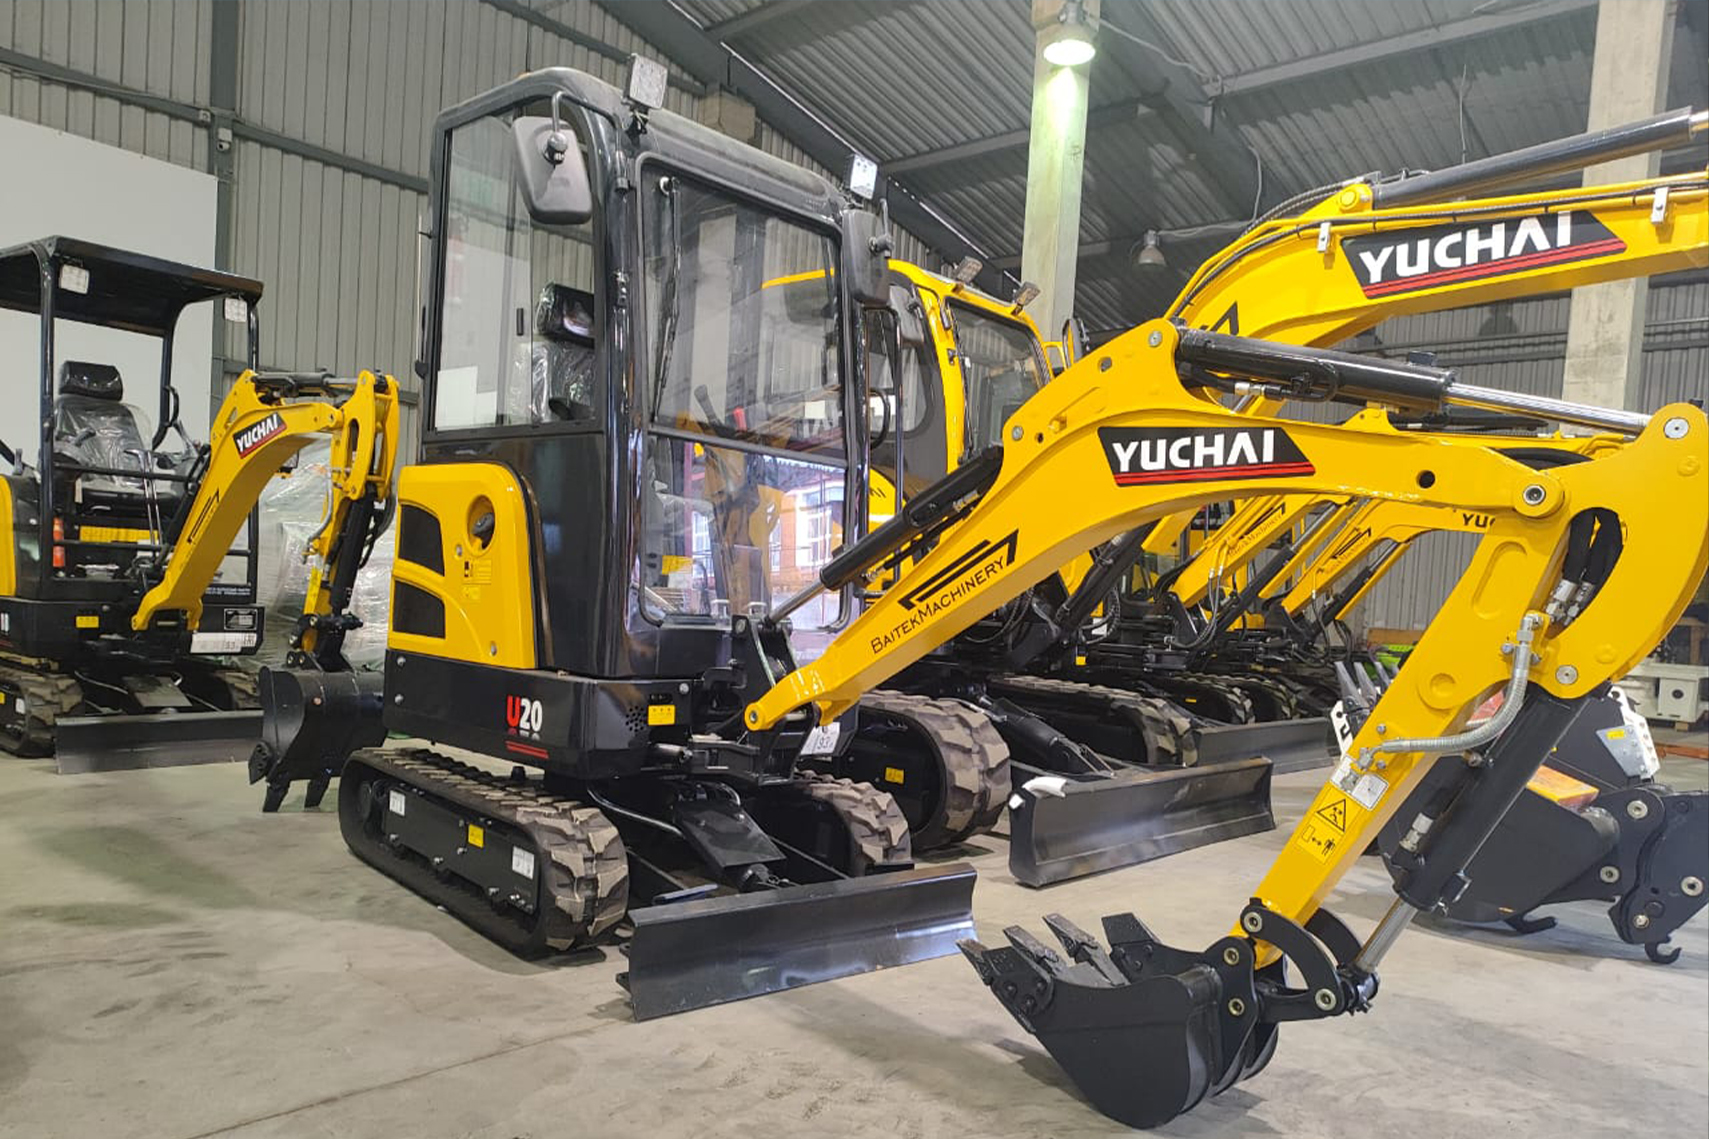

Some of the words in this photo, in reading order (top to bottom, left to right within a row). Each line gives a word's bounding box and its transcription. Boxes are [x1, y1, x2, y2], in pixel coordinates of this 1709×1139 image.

[1358, 211, 1572, 283] YUCHAI
[236, 413, 278, 453] YUCHAI
[1112, 429, 1275, 473] YUCHAI
[506, 694, 543, 732] U20
